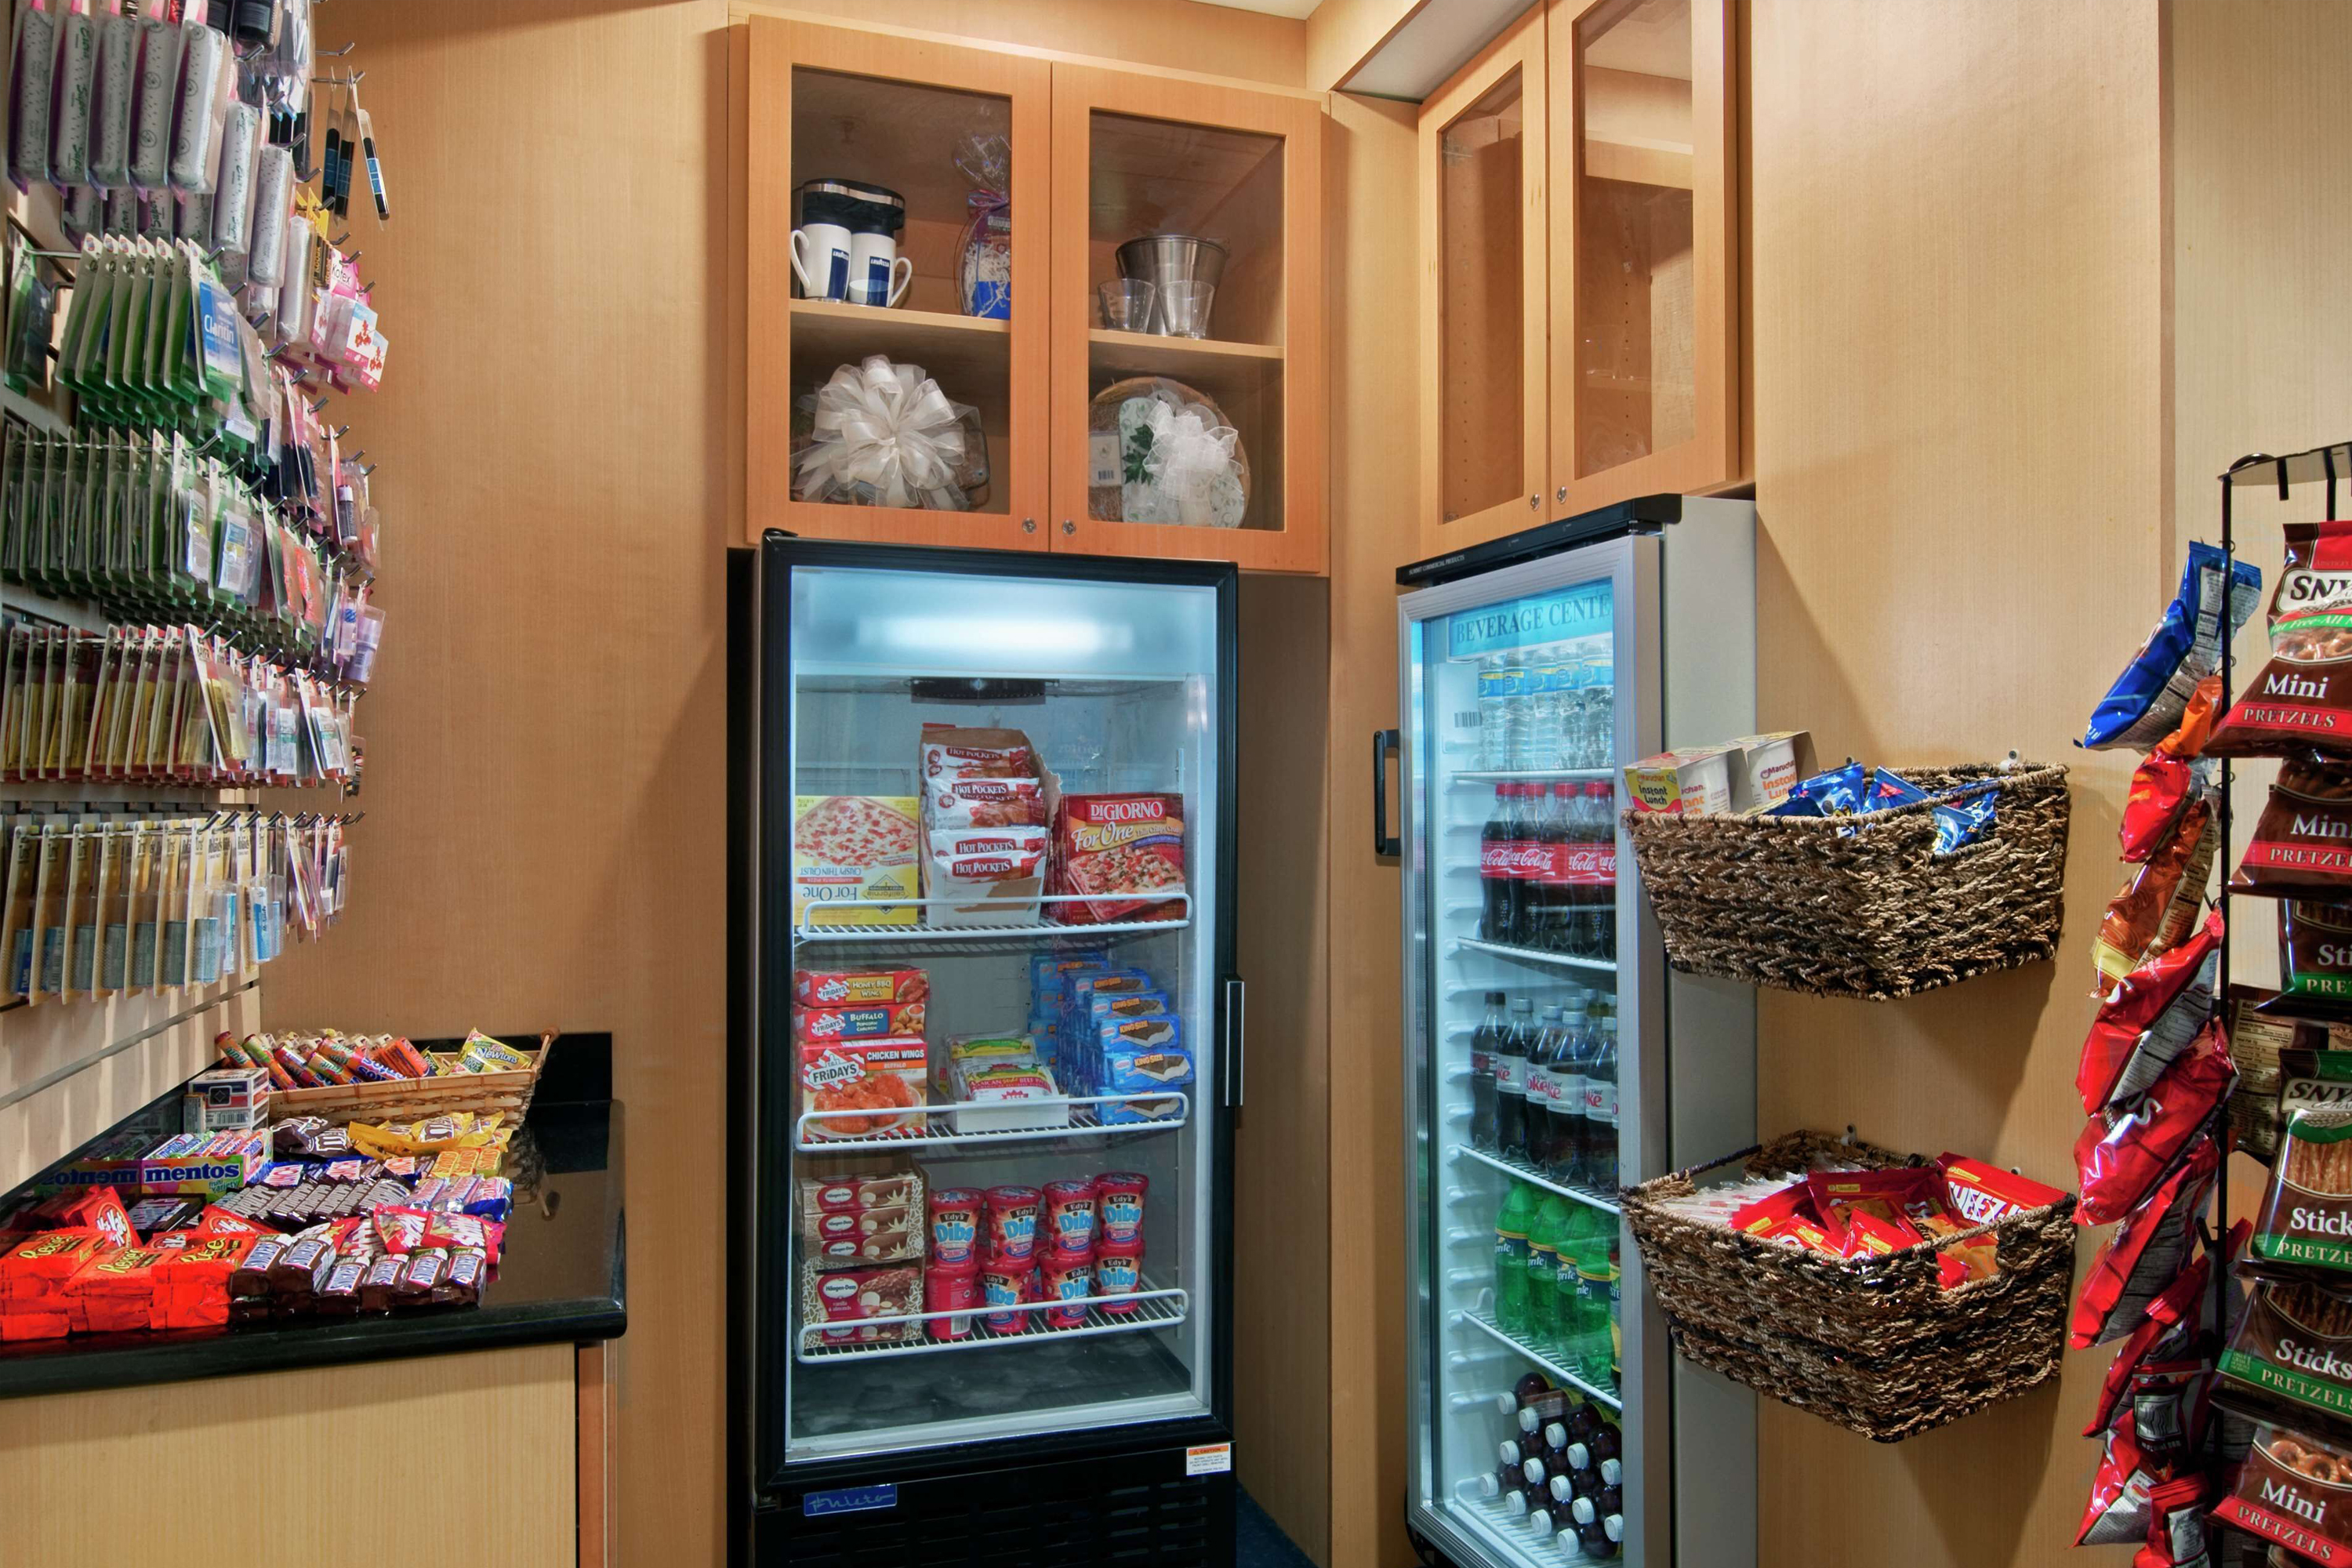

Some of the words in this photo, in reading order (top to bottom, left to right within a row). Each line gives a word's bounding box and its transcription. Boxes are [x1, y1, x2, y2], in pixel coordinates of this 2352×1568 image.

[332, 264, 351, 285] Kotex
[1457, 607, 1544, 644] BEVERAGE
[2263, 673, 2329, 699] Mini
[2244, 708, 2336, 728] PRETZELS
[955, 785, 971, 794] HOT
[973, 785, 1007, 794] POCKETS
[1639, 785, 1668, 796] Instant
[1645, 795, 1667, 806] Lunch
[1071, 827, 1100, 852] For
[1101, 822, 1134, 846] One
[959, 843, 975, 854] HOT
[978, 840, 1014, 852] POCKETS
[800, 867, 822, 876] CRUST
[823, 867, 838, 876] THIN
[840, 867, 862, 876] CRISPY
[956, 863, 972, 874] HOT
[974, 861, 1011, 873] POCKETS
[803, 887, 833, 902] One
[835, 887, 857, 902] For
[1112, 1001, 1126, 1010] KING
[1127, 998, 1139, 1007] SIZE
[851, 1013, 884, 1022] BUFFALO
[1120, 1022, 1134, 1033] KING
[1135, 1021, 1148, 1029] SIZE
[474, 1047, 518, 1064] Newtons
[867, 1051, 899, 1060] CHICKEN
[901, 1050, 924, 1059] WINGS
[1134, 1056, 1149, 1066] KING
[1150, 1054, 1163, 1062] SIZE
[144, 1163, 240, 1183] mentos
[1103, 1204, 1142, 1224] Dibs
[935, 1222, 975, 1243] Dibs
[1098, 1267, 1137, 1287] Dibs
[2276, 1338, 2352, 1380] Sticks
[2259, 1477, 2327, 1524] Mini
[2238, 1506, 2332, 1559] PRETZELS
